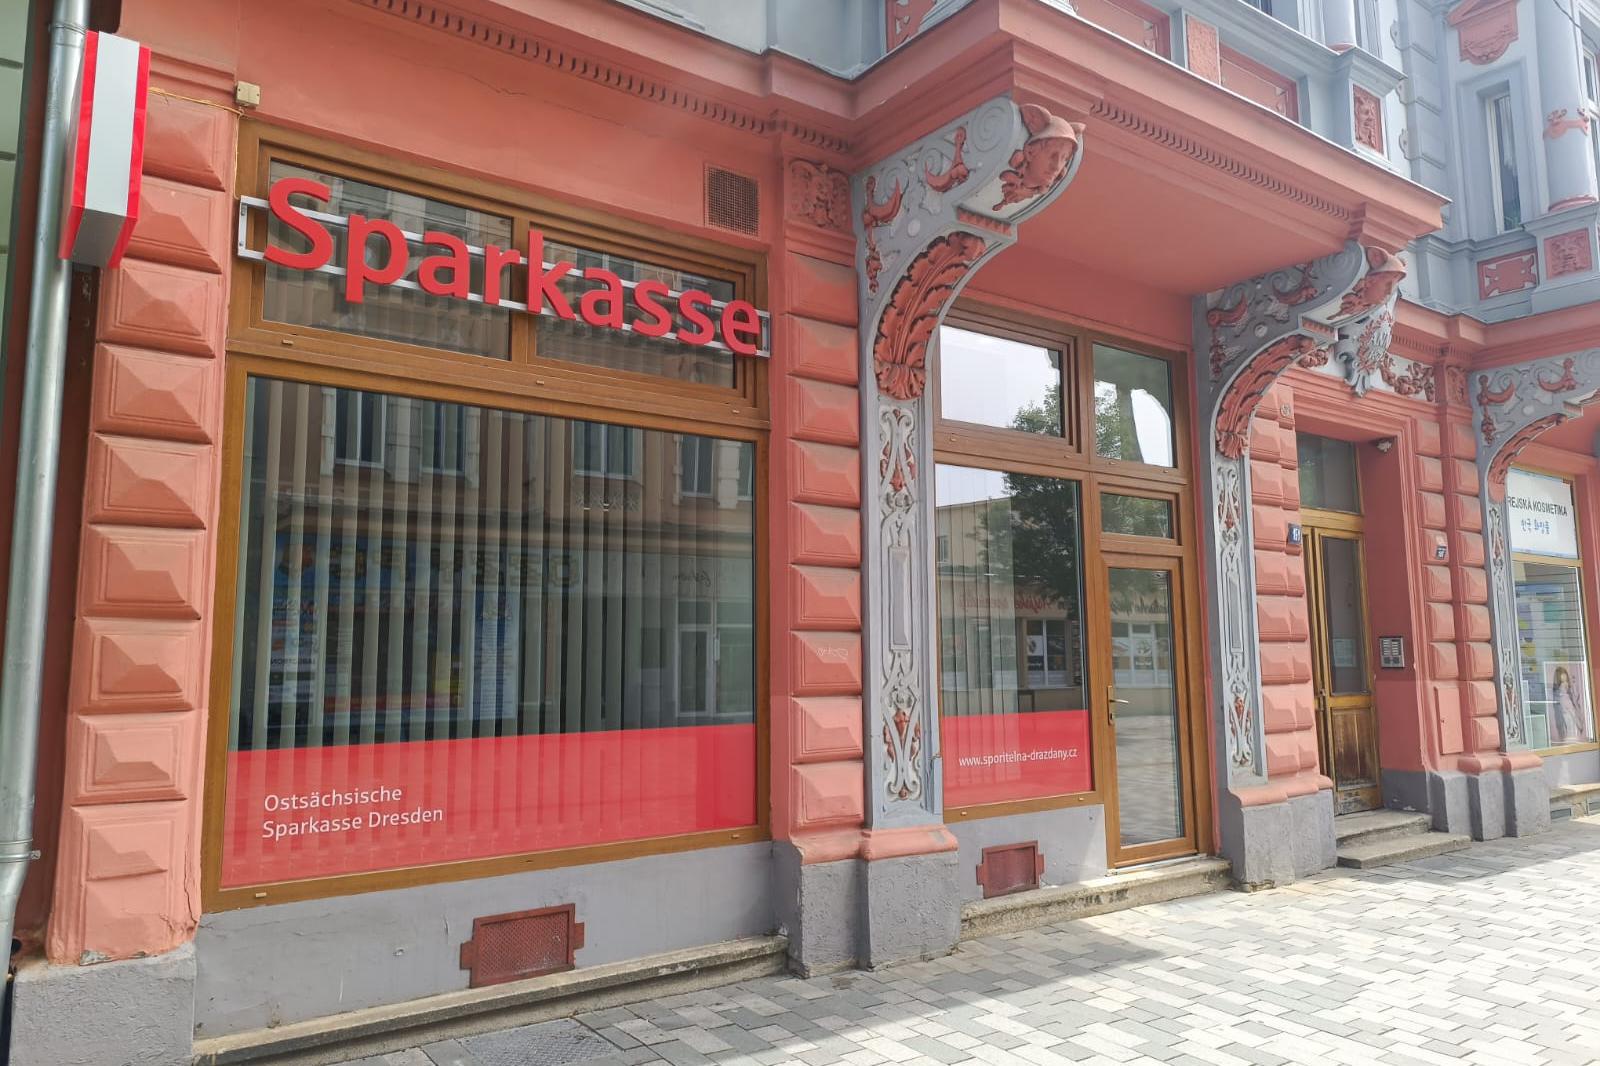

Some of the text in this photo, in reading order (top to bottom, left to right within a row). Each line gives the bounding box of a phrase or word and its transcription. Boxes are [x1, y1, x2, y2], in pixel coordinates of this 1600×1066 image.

[263, 177, 762, 355] Sparkasse
[958, 748, 1078, 768] www.sporitelna-drazdany.cz
[264, 786, 402, 812] Ostsächsische
[262, 806, 443, 842] Sparkasse Dresden
